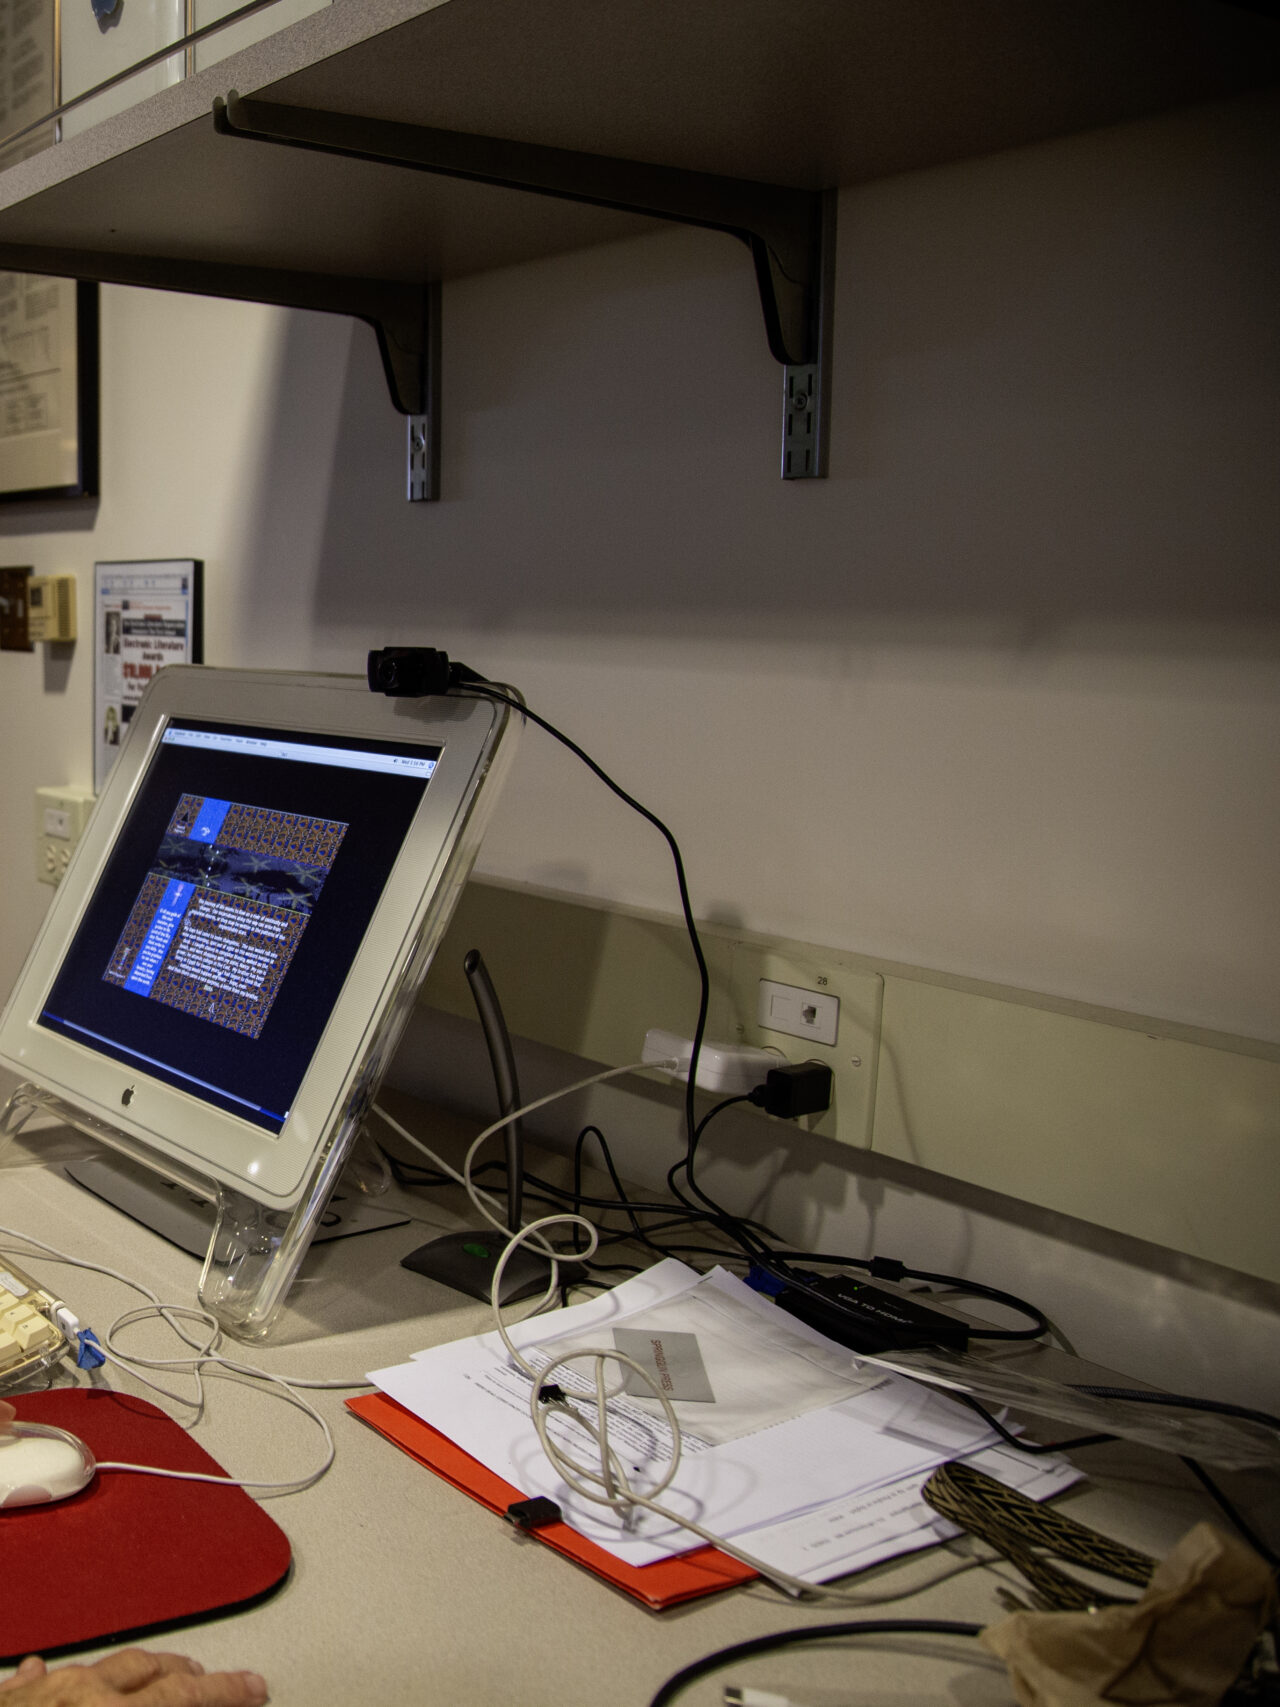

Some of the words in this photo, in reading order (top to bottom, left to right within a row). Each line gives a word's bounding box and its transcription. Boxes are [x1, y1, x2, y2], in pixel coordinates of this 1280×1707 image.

[817, 976, 827, 986] 28
[837, 1293, 859, 1304] VGA
[861, 1302, 875, 1311] TO
[660, 1373, 674, 1391] PRESS
